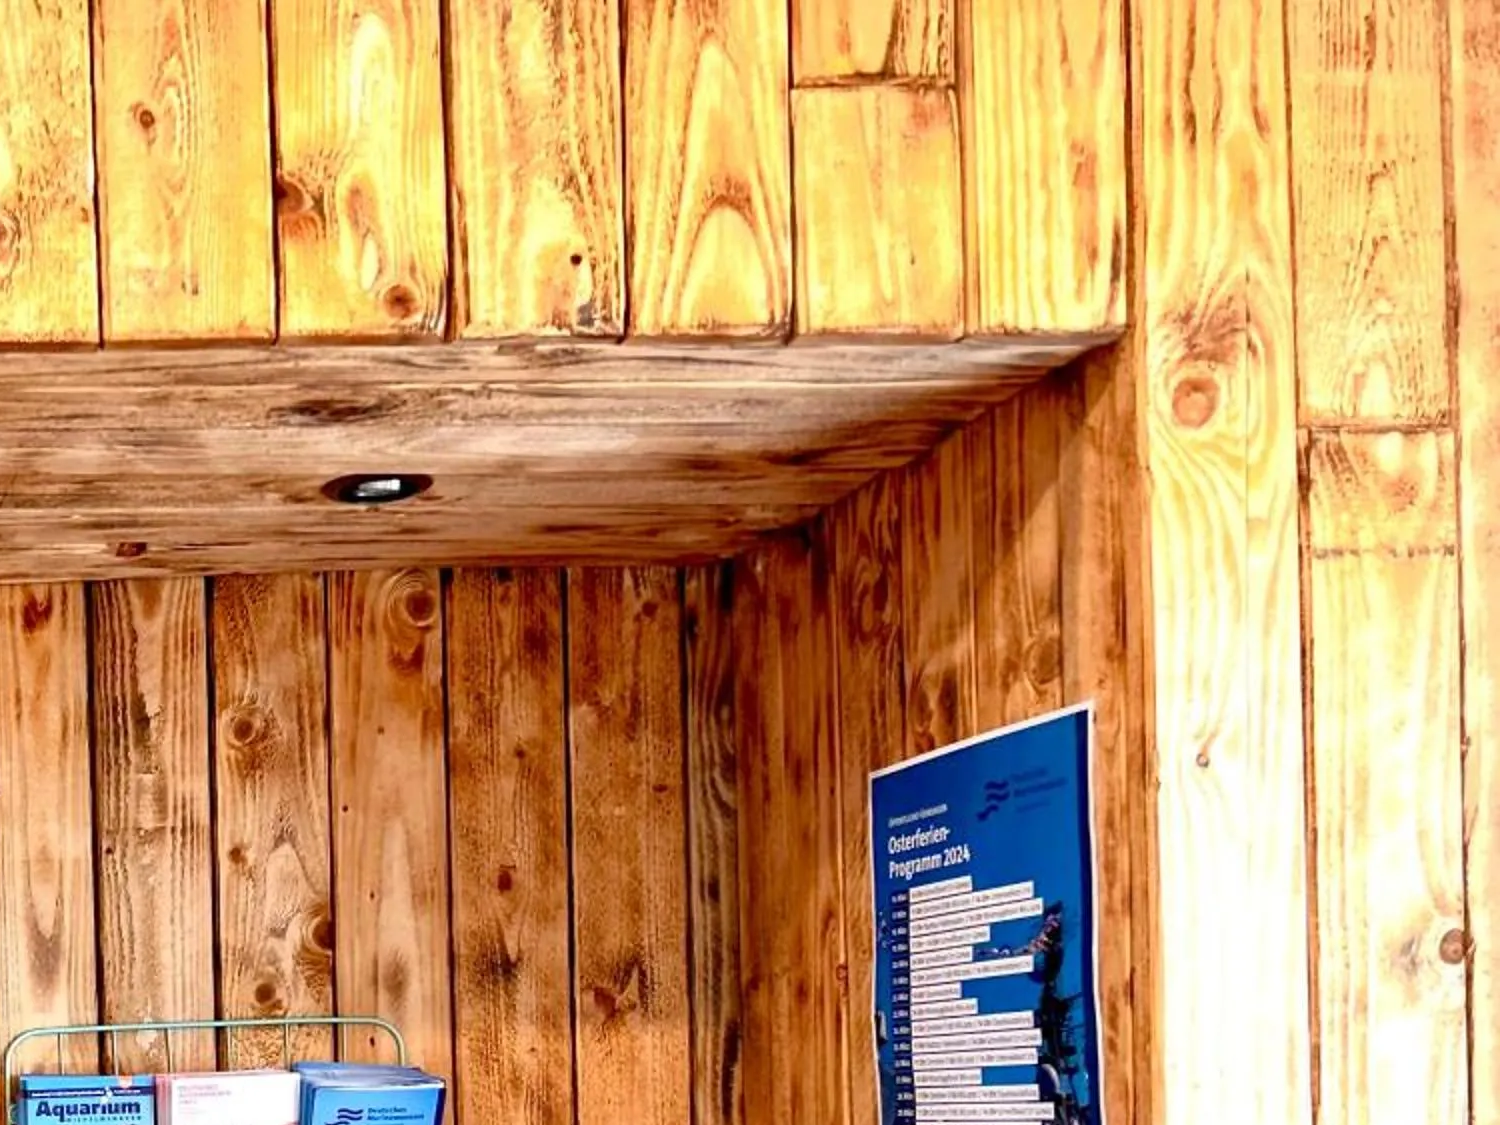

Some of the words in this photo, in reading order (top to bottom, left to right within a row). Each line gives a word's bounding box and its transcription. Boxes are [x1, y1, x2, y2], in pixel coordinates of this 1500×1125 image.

[887, 825, 950, 855] Osterferien-
[889, 850, 943, 881] Programm
[943, 844, 971, 868] 2024
[36, 1101, 141, 1122] Aquarium
